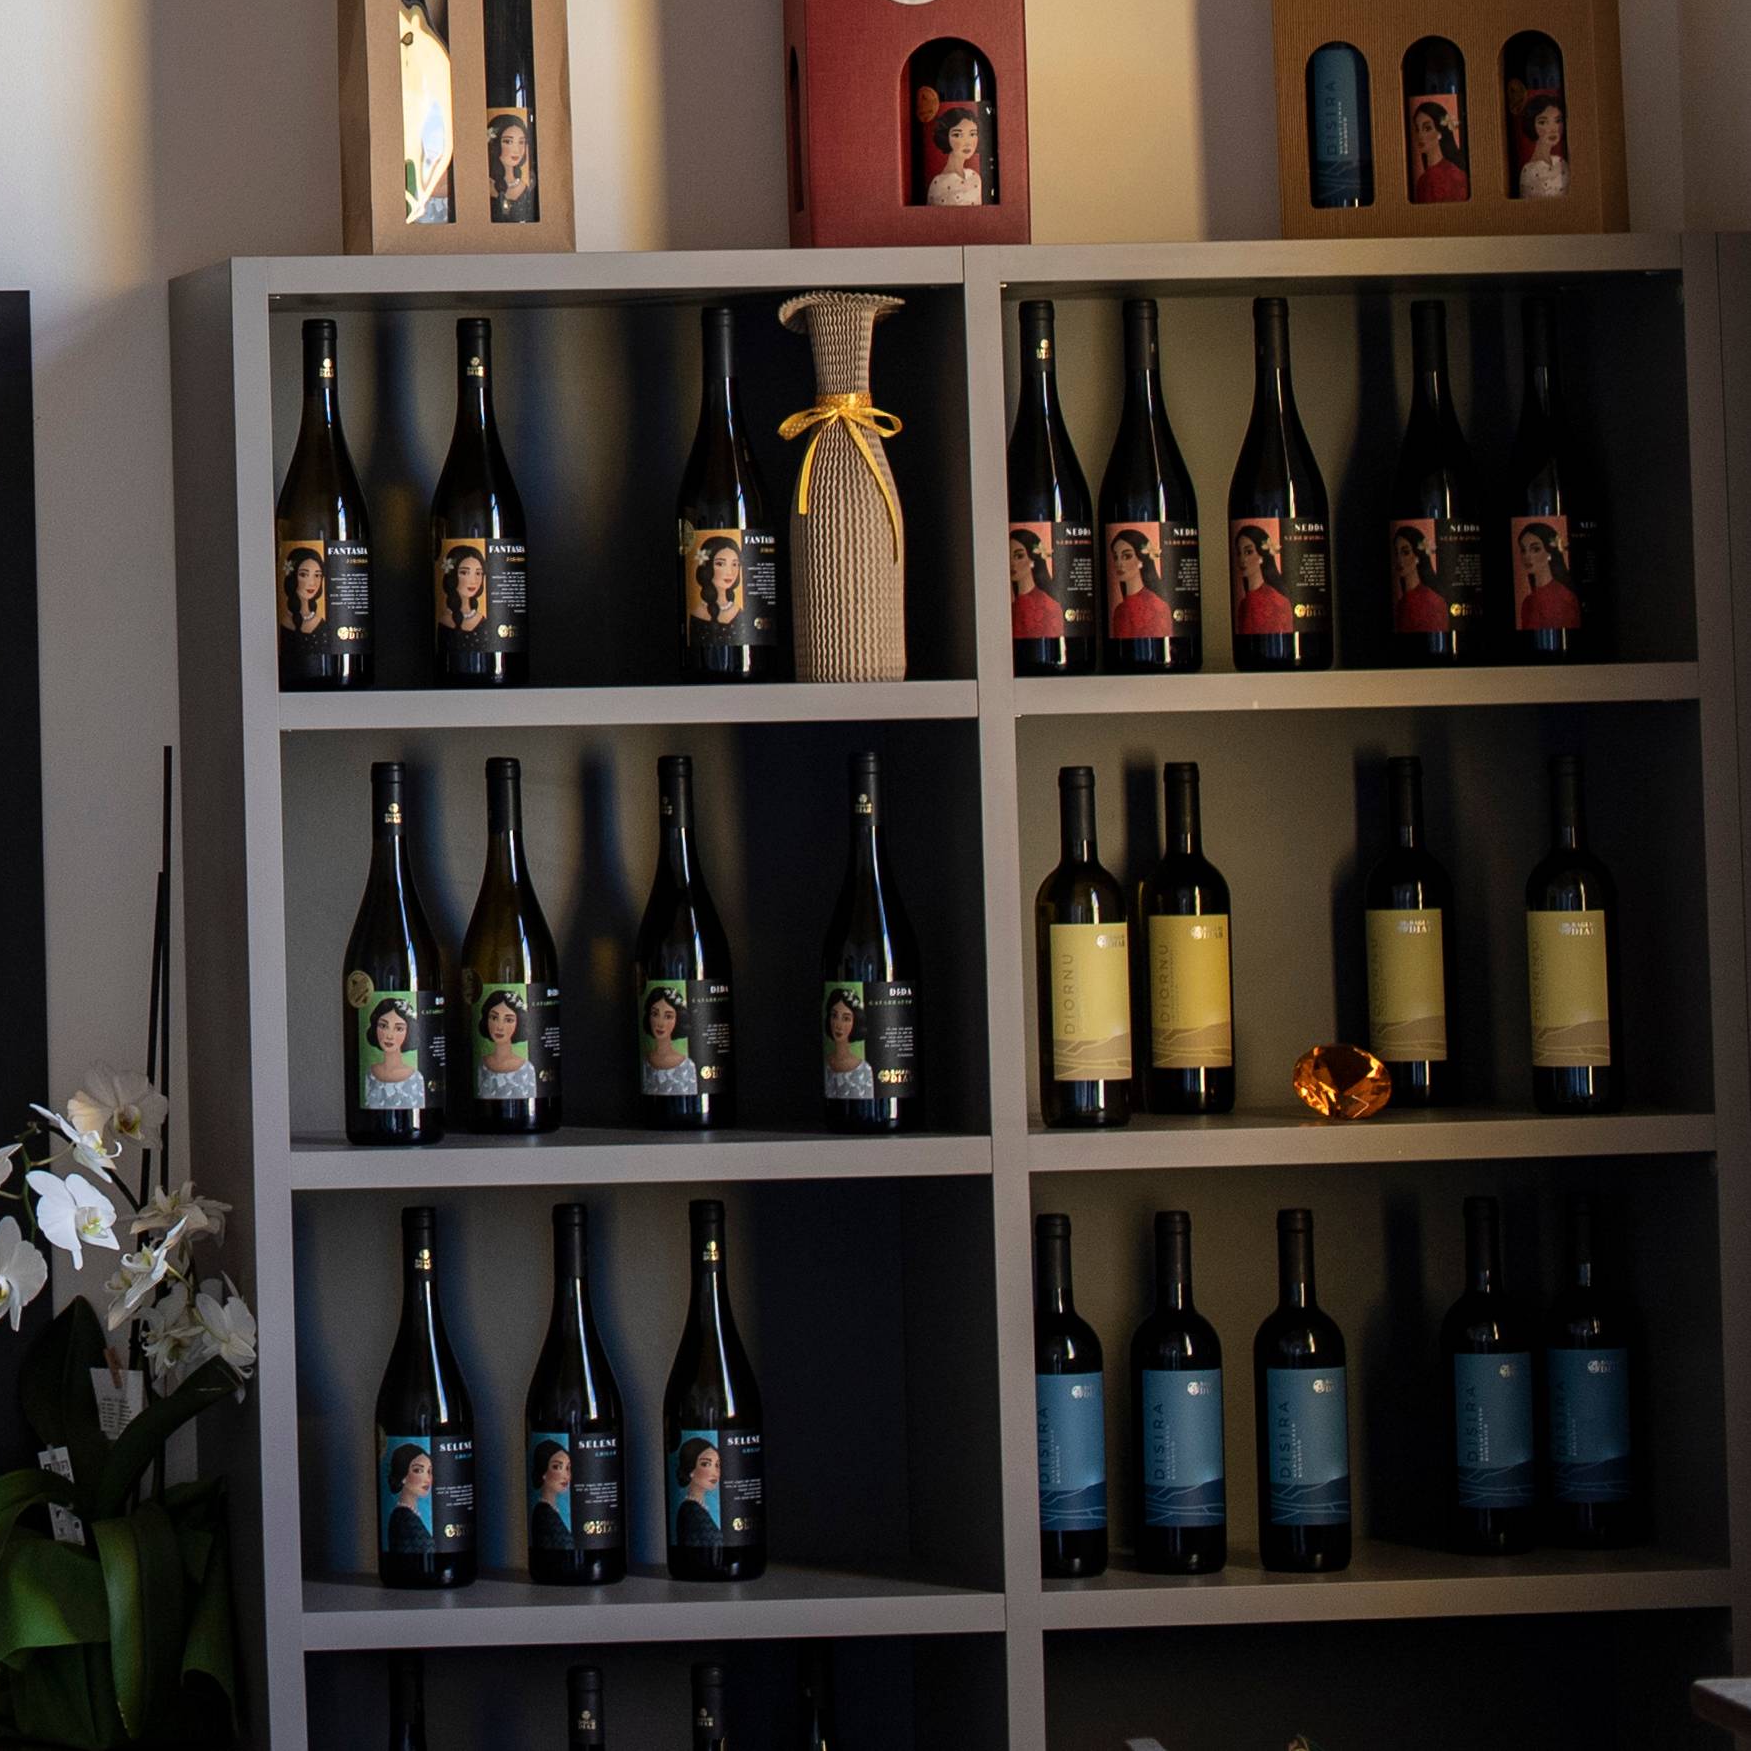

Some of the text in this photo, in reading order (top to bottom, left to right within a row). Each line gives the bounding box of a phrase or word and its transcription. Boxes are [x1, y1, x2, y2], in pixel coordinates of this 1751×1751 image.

[1061, 954, 1075, 1035] DIORNU
[1158, 944, 1170, 1023] DIORNU
[1153, 1403, 1165, 1481] DISIRA
[1278, 1401, 1291, 1479] DISIRA
